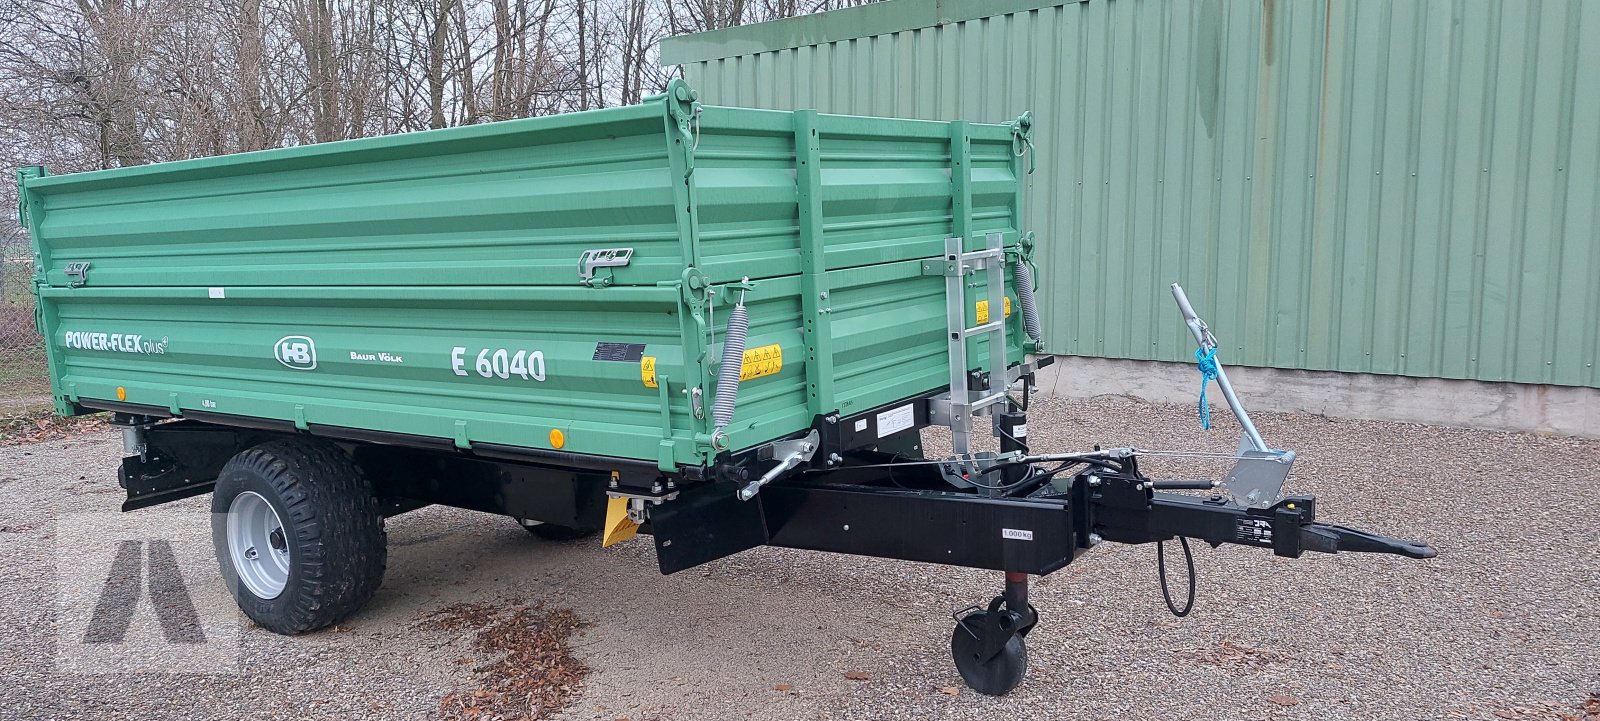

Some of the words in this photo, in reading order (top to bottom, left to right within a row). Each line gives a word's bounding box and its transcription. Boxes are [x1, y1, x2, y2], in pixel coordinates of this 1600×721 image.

[65, 331, 145, 354] POWER-FLEX
[451, 346, 469, 377] E
[476, 348, 546, 382] 6040
